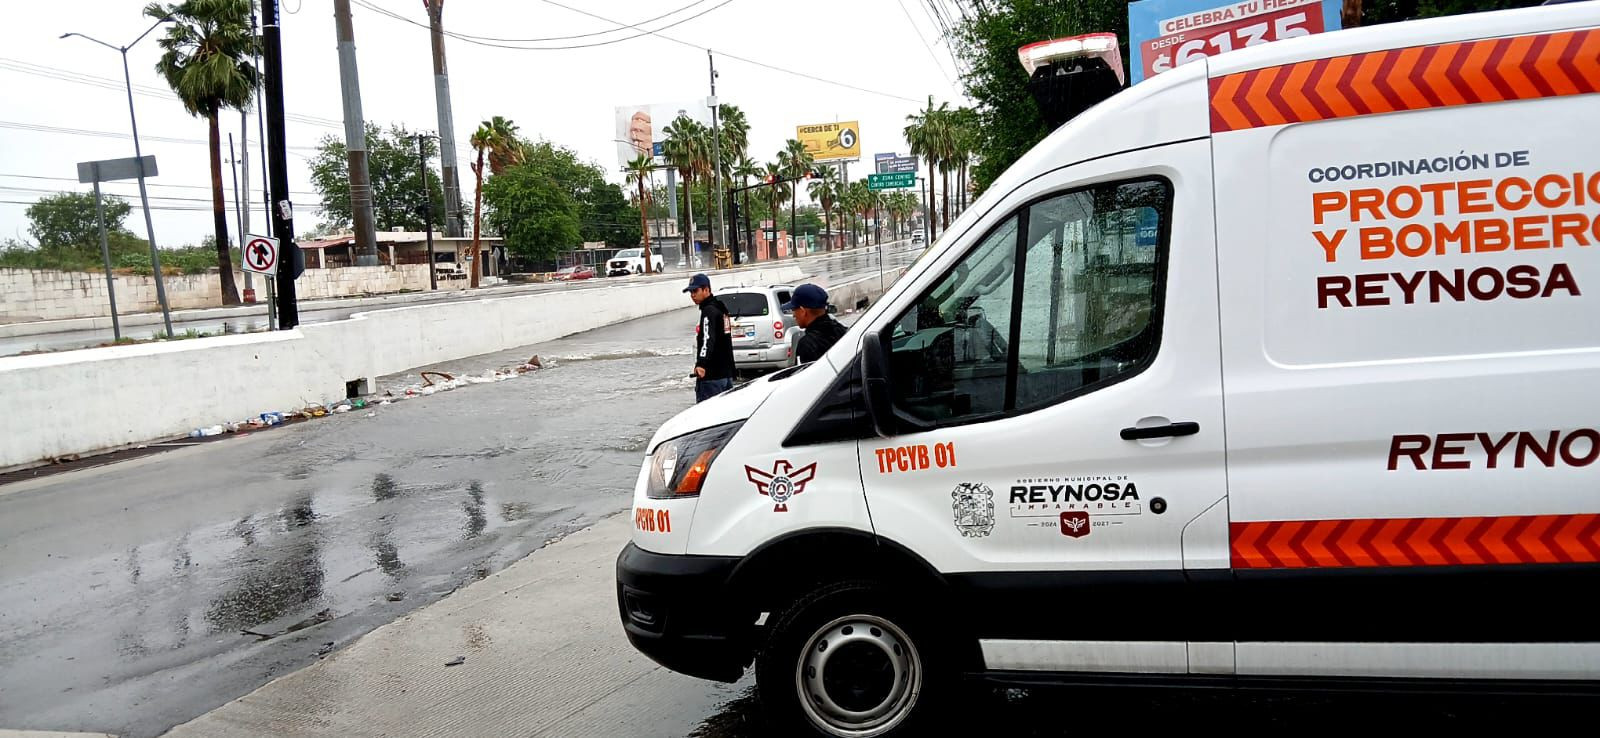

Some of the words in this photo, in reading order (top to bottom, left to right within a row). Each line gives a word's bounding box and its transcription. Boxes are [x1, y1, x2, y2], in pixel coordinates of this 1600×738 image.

[1165, 9, 1234, 32] CELEBRA
[1238, 3, 1258, 17] TU
[1151, 34, 1185, 51] DESDE
[1308, 150, 1489, 183] COORDINACIÓN
[1495, 150, 1529, 168] DE
[1312, 229, 1348, 263] Y
[1359, 213, 1600, 260] BOMBER
[1317, 263, 1581, 309] REYNOSA
[875, 445, 930, 473] TPCYB
[935, 442, 956, 468] 01
[1387, 428, 1600, 470] REYNO
[1009, 482, 1139, 503] REYNOSA
[1018, 502, 1131, 510] IMPARABLE
[657, 509, 671, 532] 01
